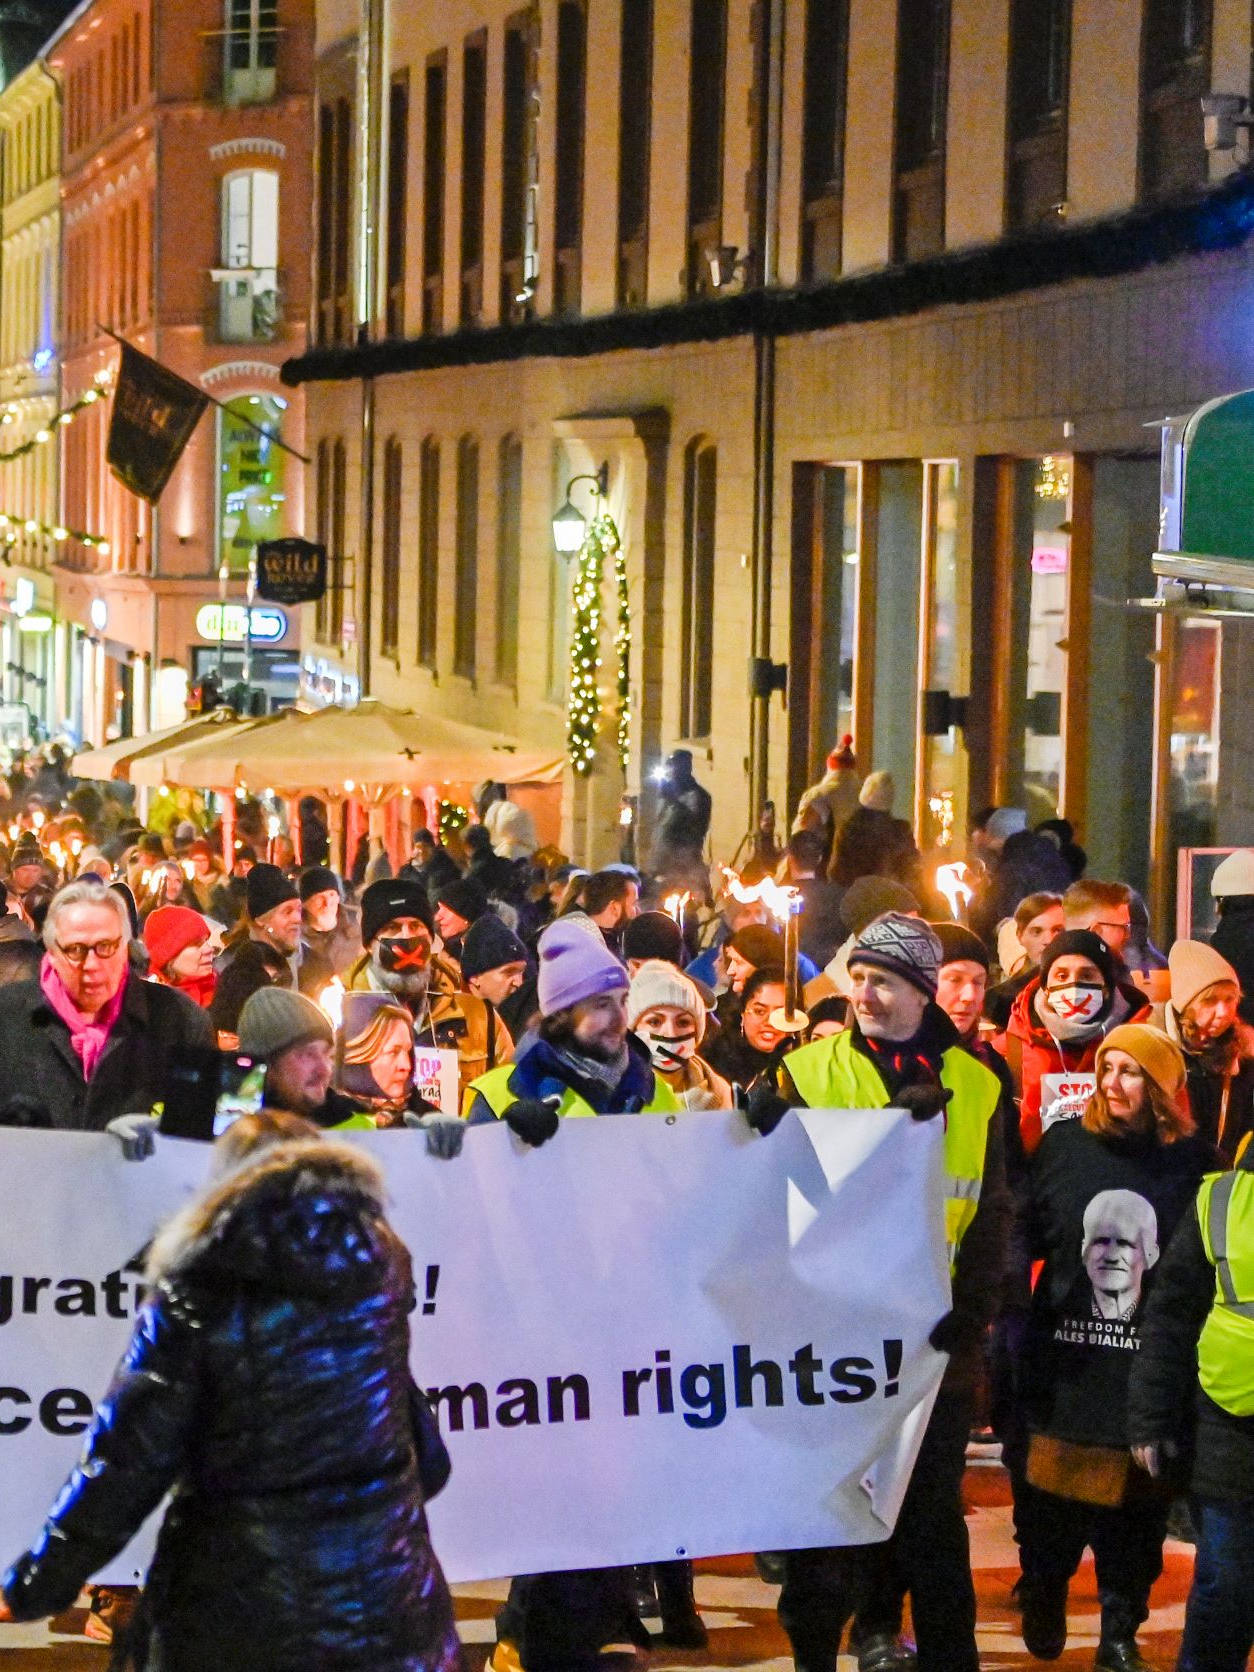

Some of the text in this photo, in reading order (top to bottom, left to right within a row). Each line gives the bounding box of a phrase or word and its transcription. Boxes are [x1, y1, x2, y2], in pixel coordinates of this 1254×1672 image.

[1058, 1083, 1093, 1098] STO
[1063, 1320, 1125, 1335] FREEDOM
[1053, 1328, 1142, 1351] ALES BIALIAT
[430, 1370, 591, 1432] man
[622, 1339, 904, 1430] rights!
